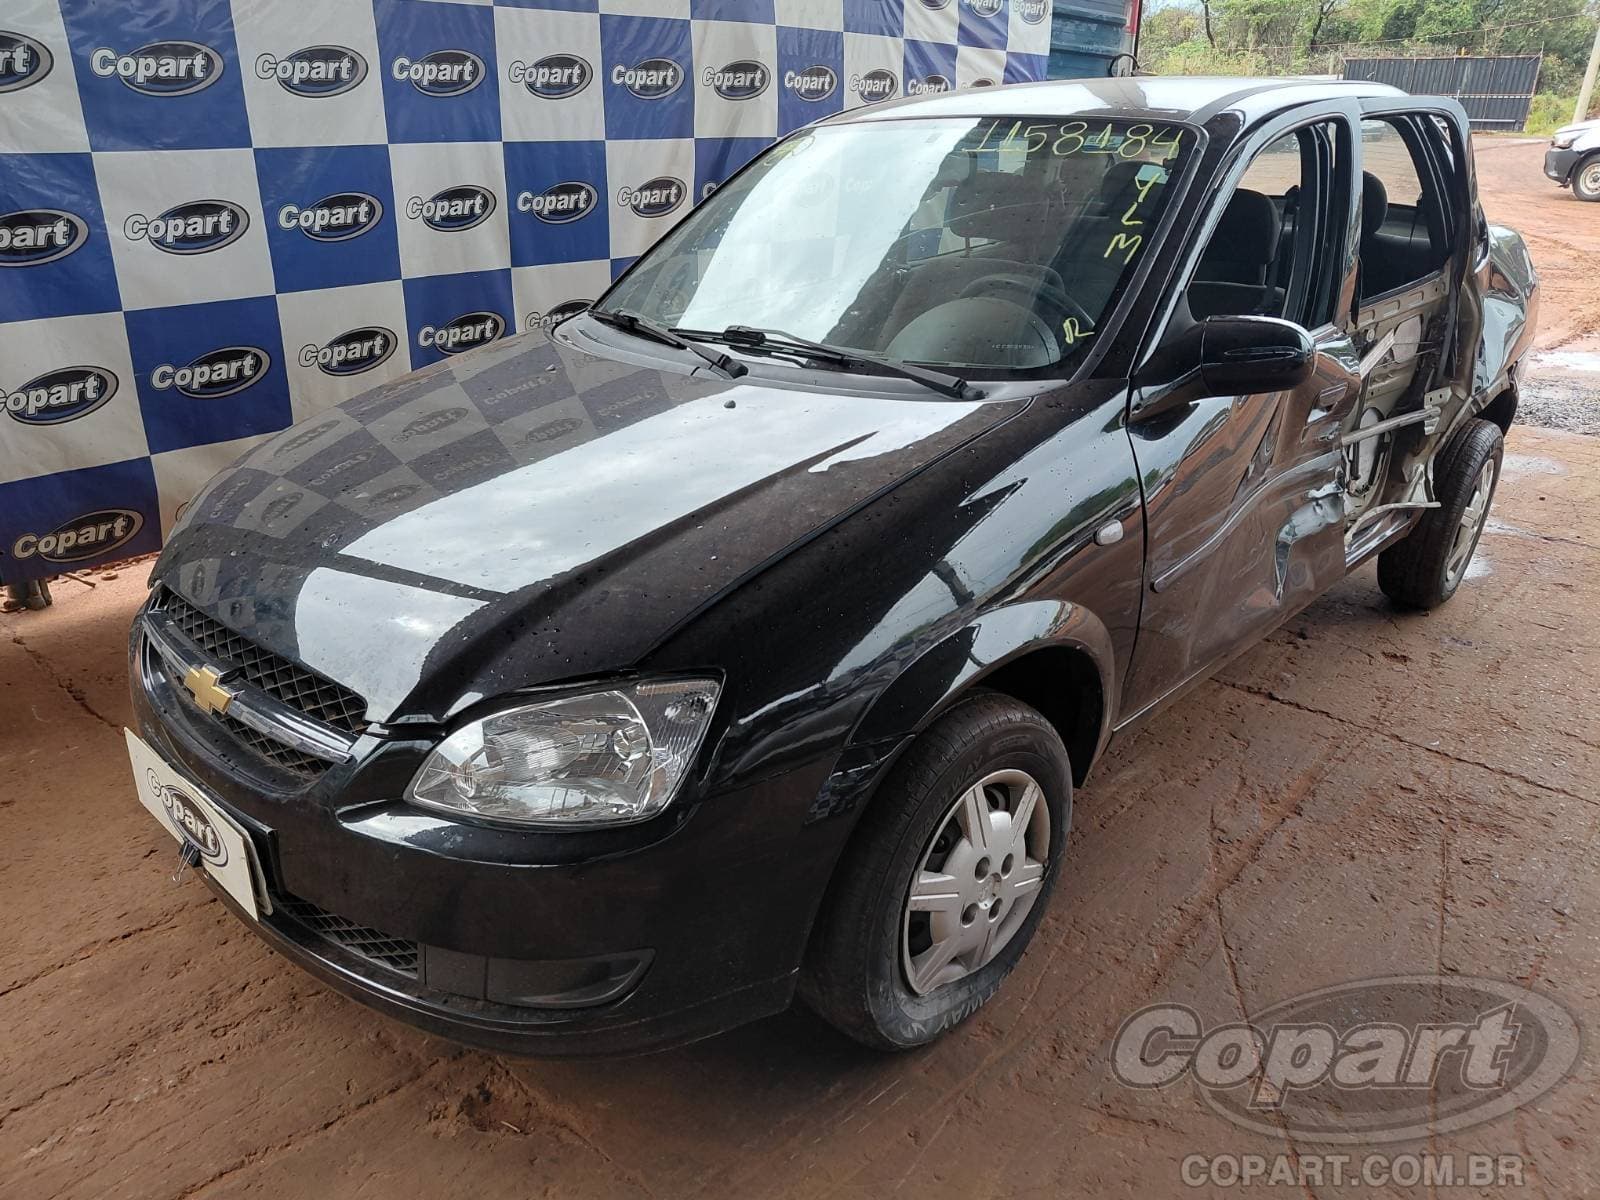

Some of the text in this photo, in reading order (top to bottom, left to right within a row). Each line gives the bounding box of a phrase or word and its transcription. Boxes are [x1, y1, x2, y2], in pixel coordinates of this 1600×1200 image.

[90, 47, 207, 85] Copart
[255, 53, 353, 85] Copart
[392, 57, 476, 87] Copart
[509, 61, 582, 87] Copart
[611, 65, 675, 88] Copart
[702, 67, 763, 89] Copart
[784, 71, 832, 93] Copart
[850, 75, 893, 95] Copart
[406, 193, 485, 222] Copart
[516, 186, 588, 215] Copart
[617, 183, 679, 208] Copart
[124, 208, 233, 244] Copart
[279, 198, 371, 233] Copart
[418, 316, 496, 348] Copart
[299, 331, 384, 368] Copart
[152, 347, 256, 390] Copart
[0, 372, 100, 417] opart
[13, 515, 129, 559] Copart
[146, 767, 219, 851] Copart
